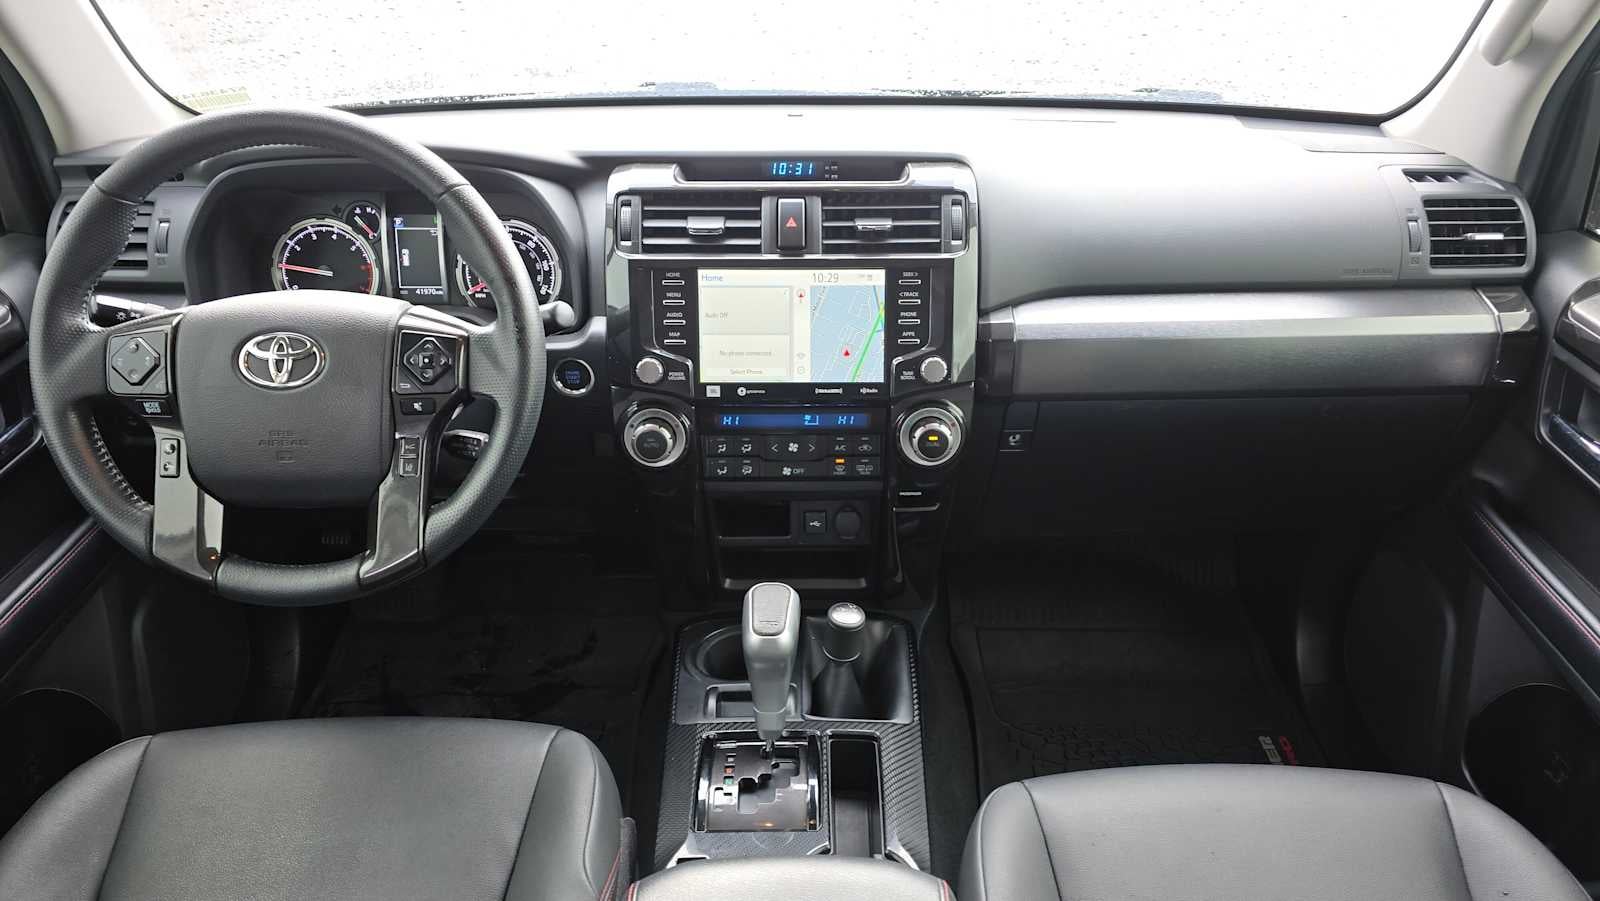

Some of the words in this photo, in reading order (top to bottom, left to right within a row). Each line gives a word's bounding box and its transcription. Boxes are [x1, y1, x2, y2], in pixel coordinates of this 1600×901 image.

[772, 162, 813, 175] 10:31
[311, 233, 318, 241] 3
[294, 244, 301, 252] 2
[350, 244, 357, 252] 5
[701, 272, 724, 282] Home
[812, 272, 840, 283] 10:29
